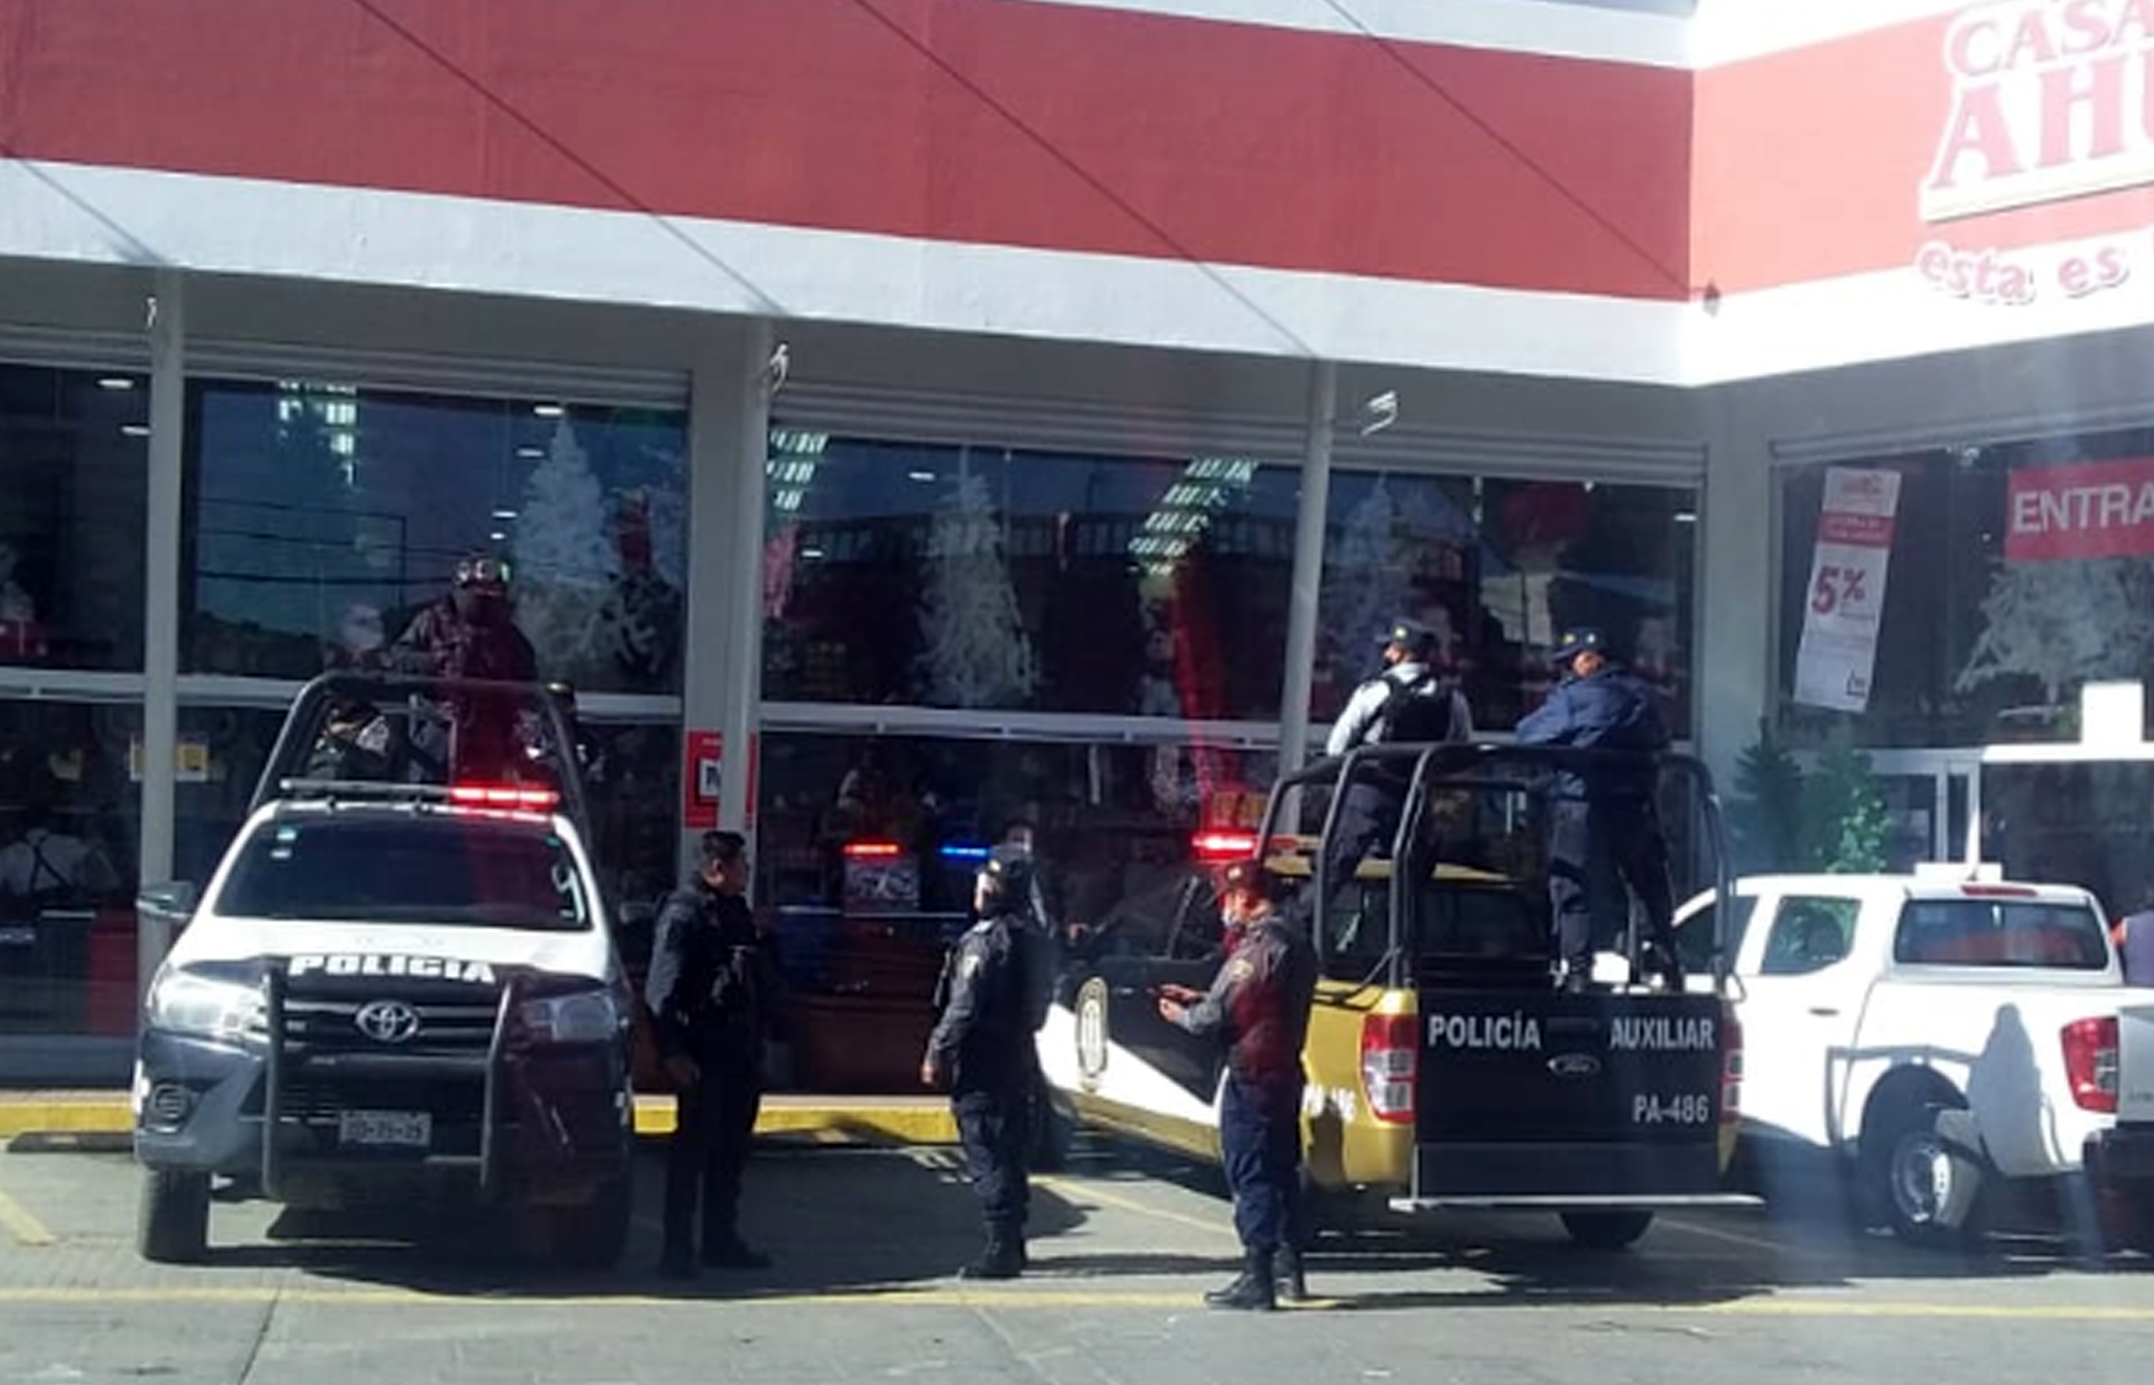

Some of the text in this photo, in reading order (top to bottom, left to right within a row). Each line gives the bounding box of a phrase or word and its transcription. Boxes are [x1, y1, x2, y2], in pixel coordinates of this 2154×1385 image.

[1919, 246, 2125, 301] esta es
[289, 955, 495, 982] POLICIA
[1427, 1010, 1715, 1049] POLICÍA AUXILIAR
[1633, 1094, 1710, 1123] PA-486
